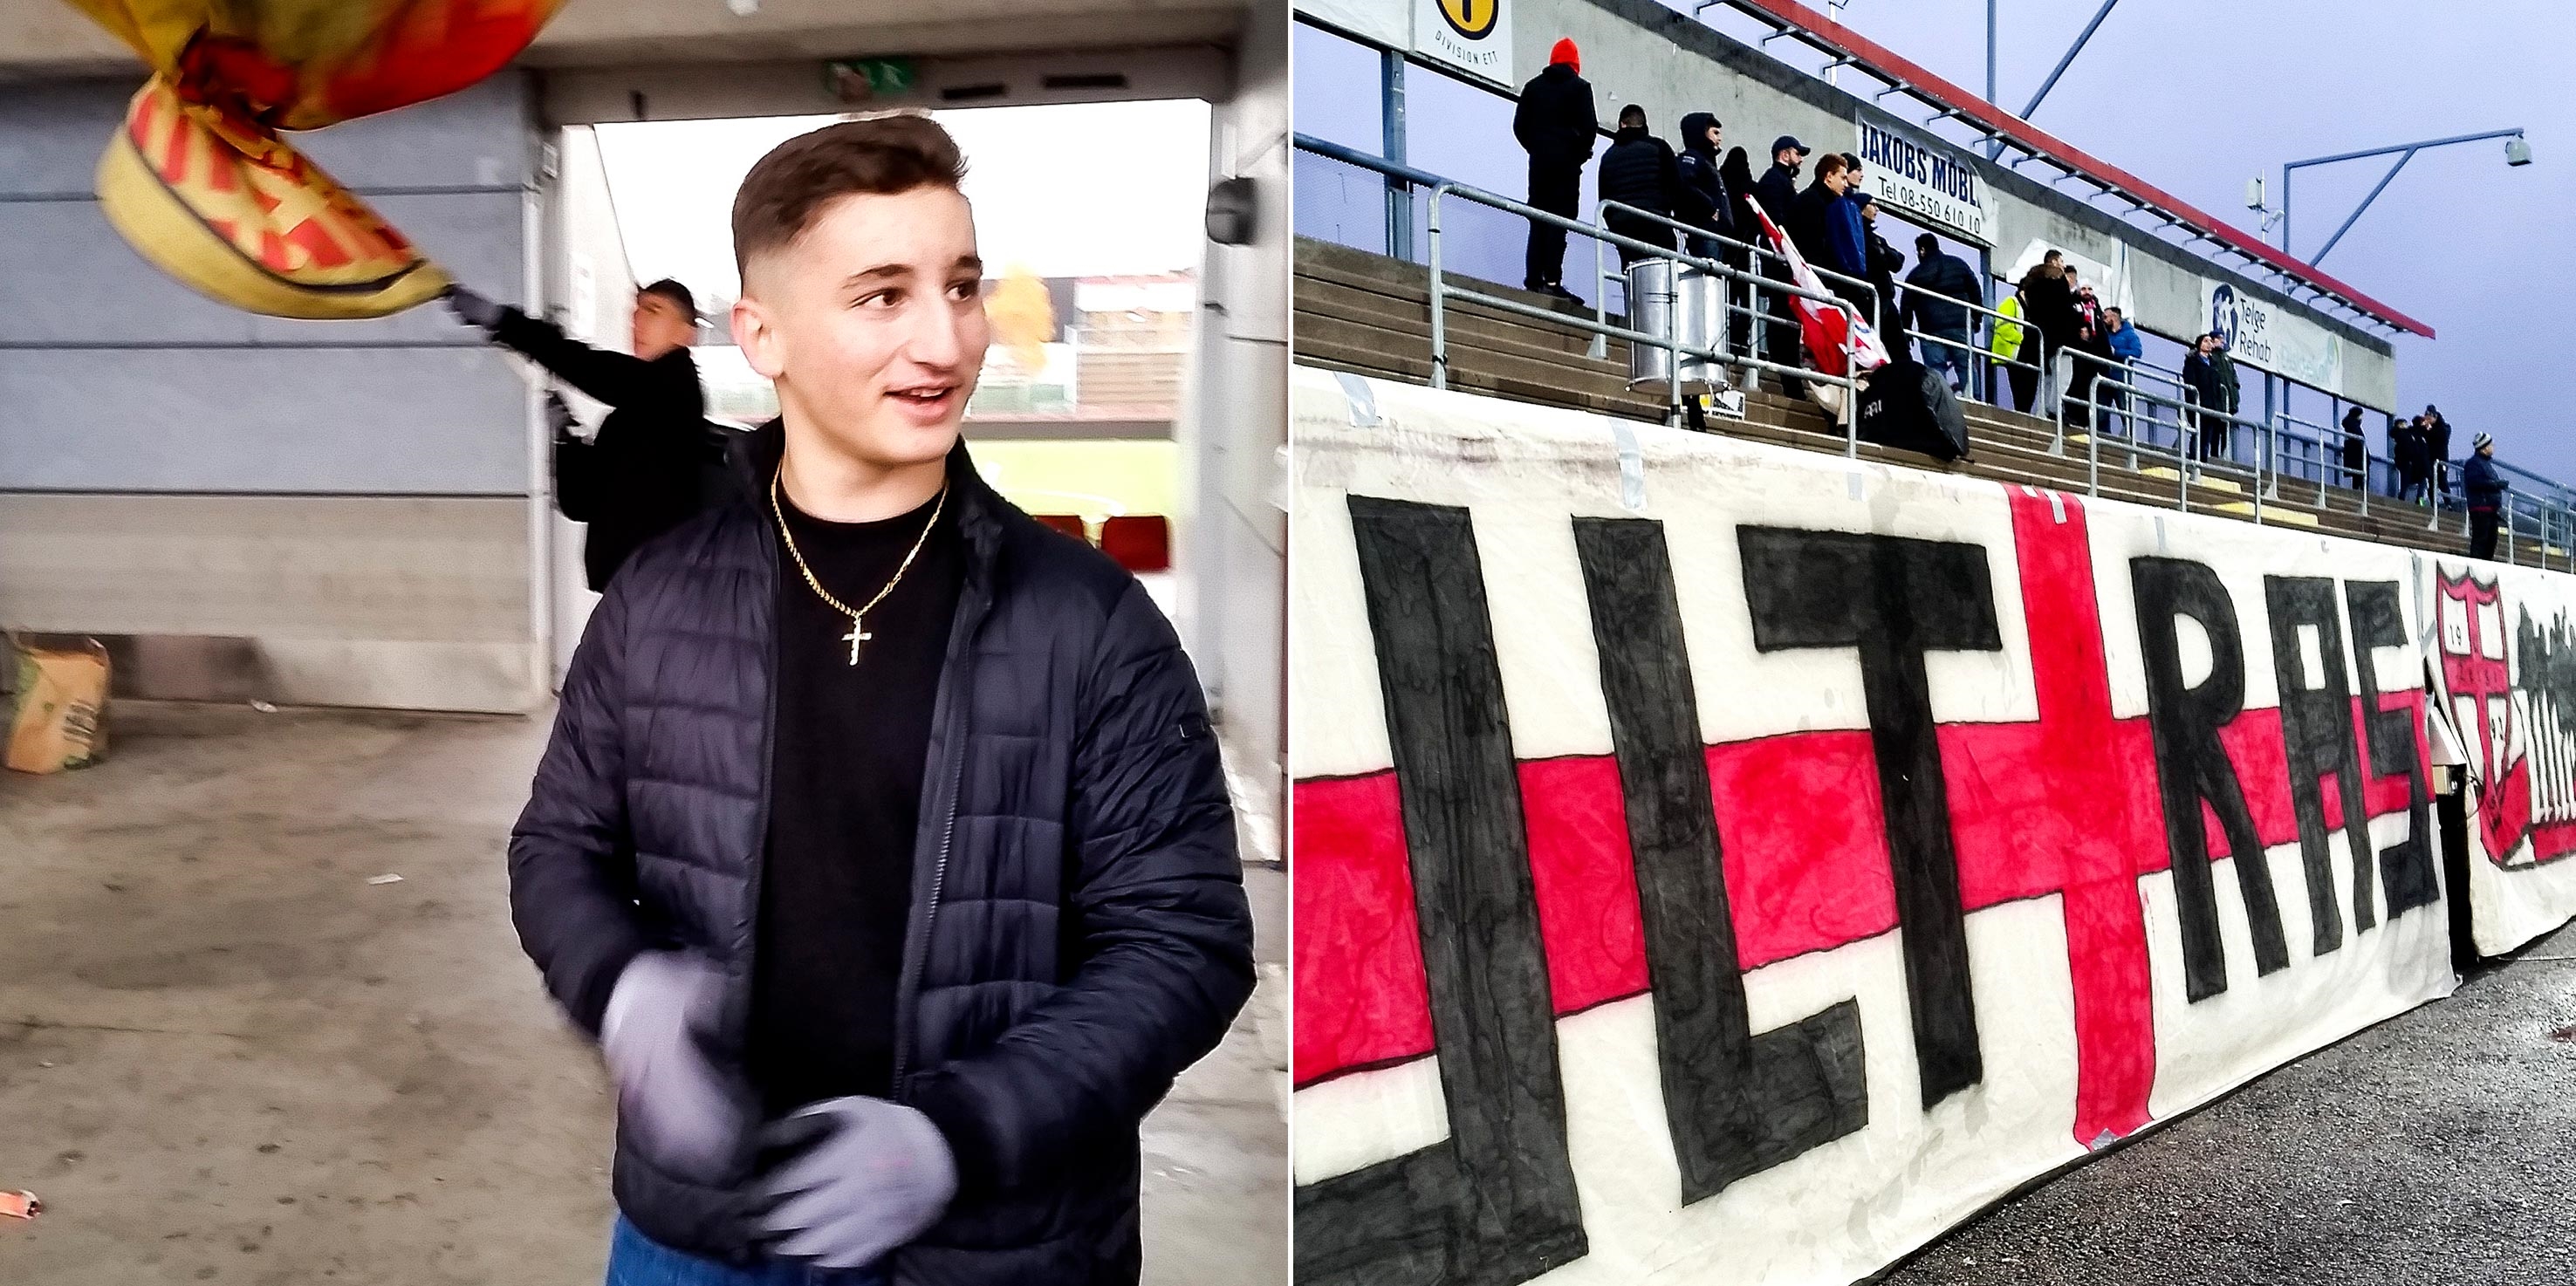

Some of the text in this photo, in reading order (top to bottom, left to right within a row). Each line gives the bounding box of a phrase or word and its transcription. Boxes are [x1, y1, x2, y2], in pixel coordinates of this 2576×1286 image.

[1435, 30, 1497, 65] DIVISION ETT
[1861, 121, 1928, 185] JAKOBS
[1878, 175, 1981, 234] Tel 08-550 610 10
[2240, 298, 2266, 333] Telge
[2239, 331, 2271, 363] Rehab
